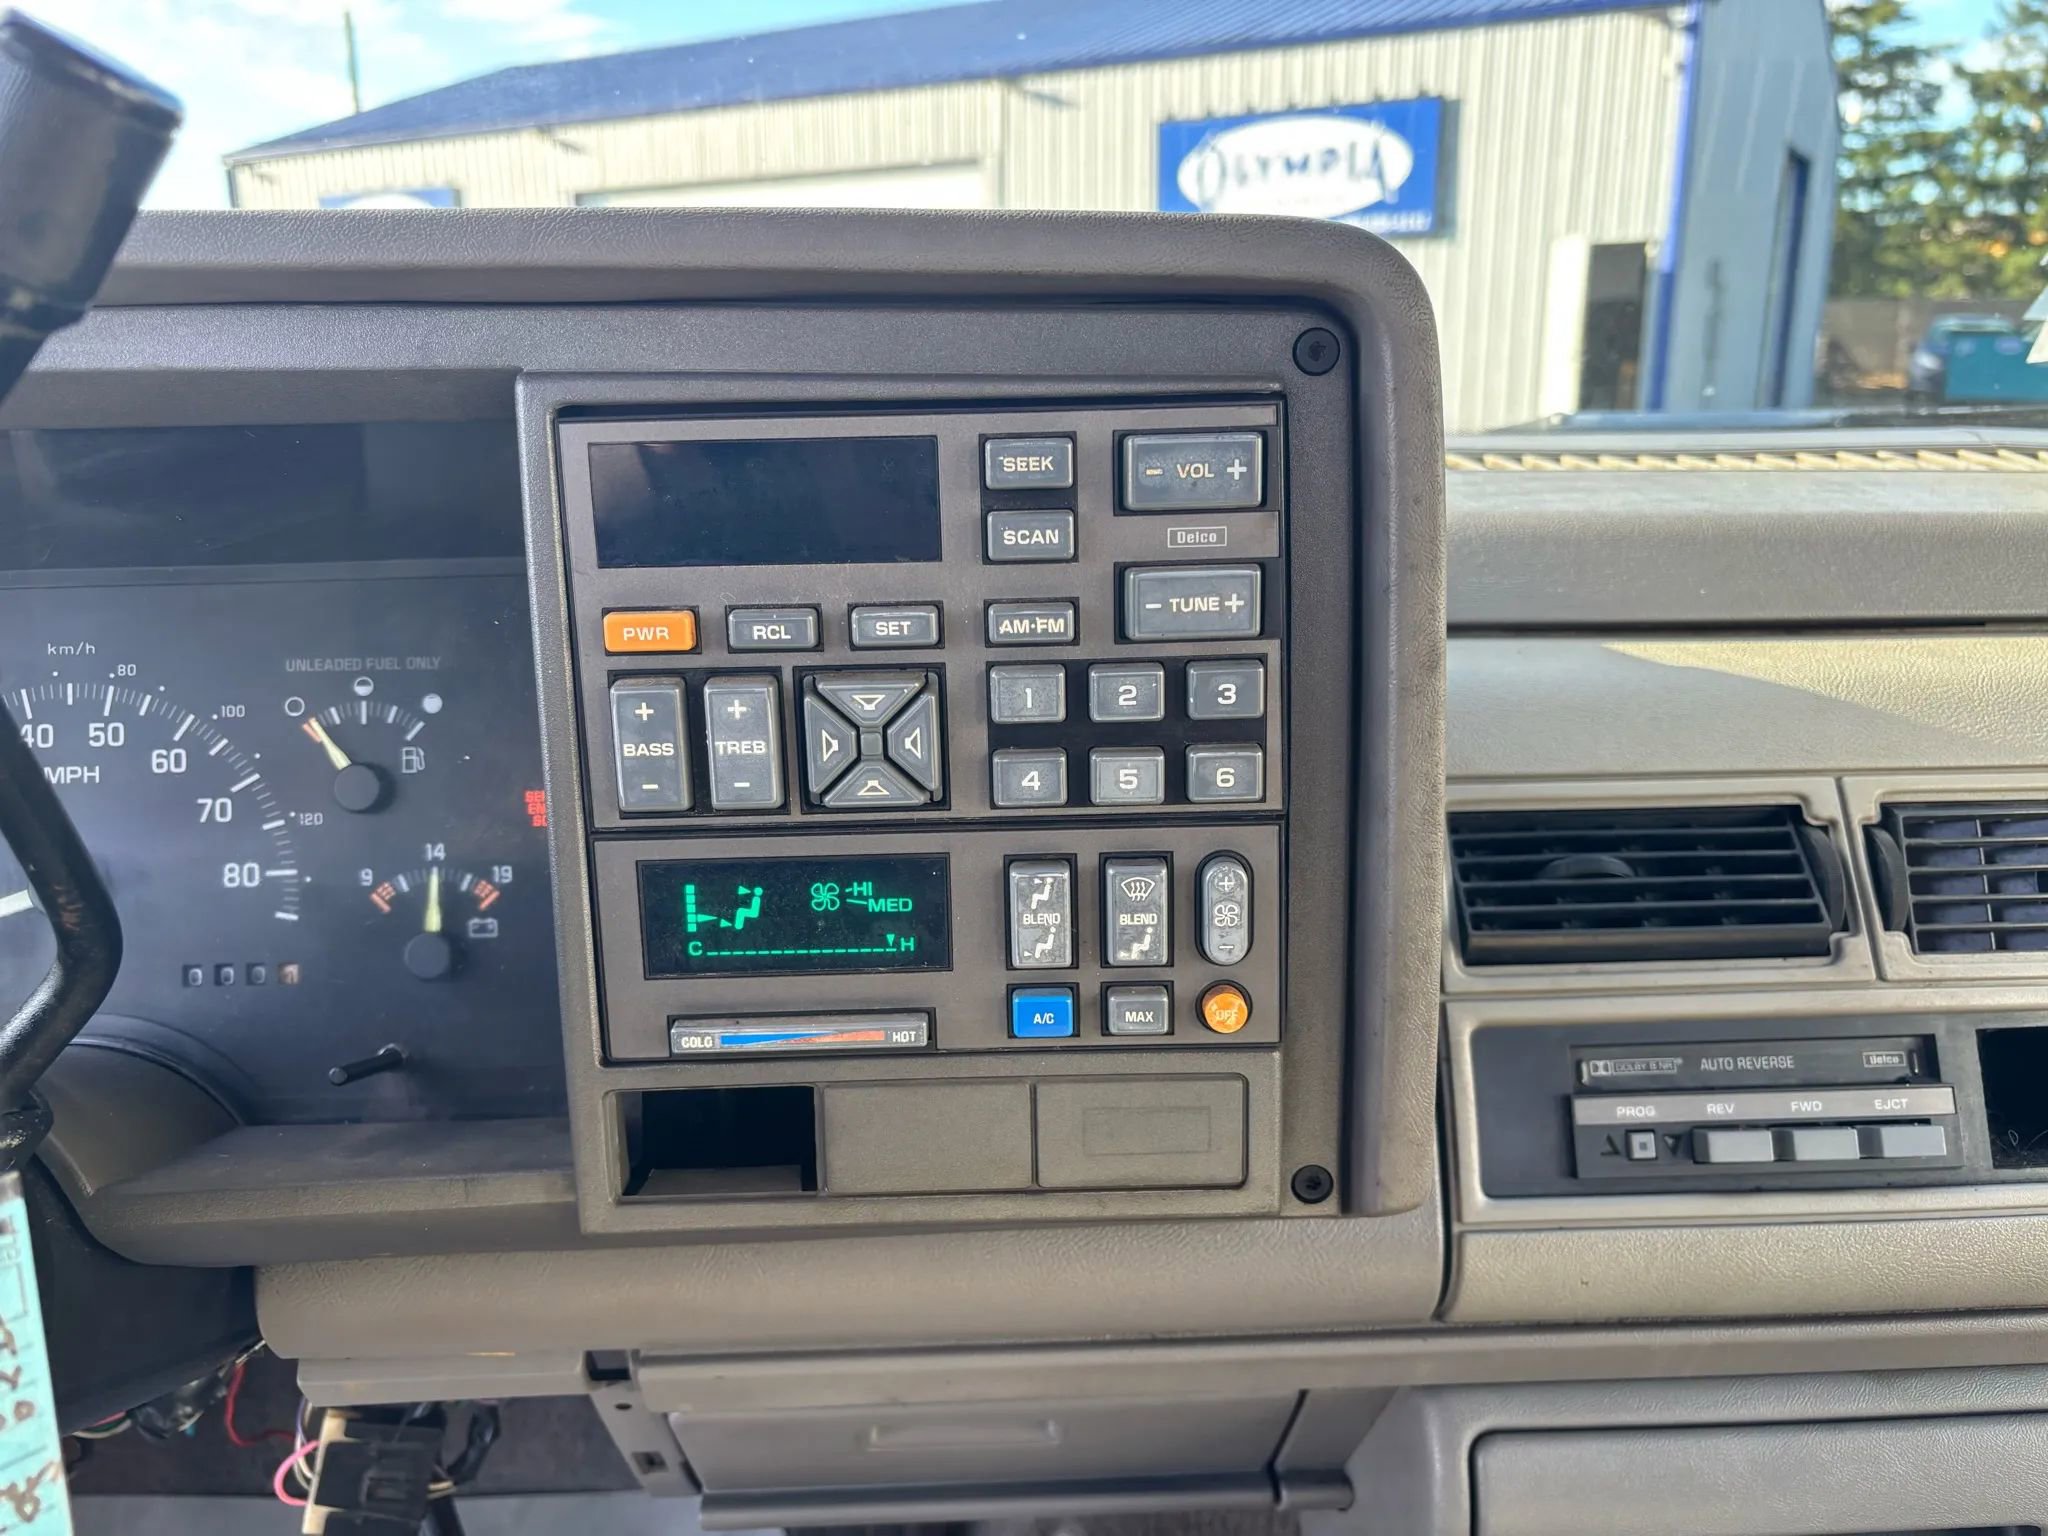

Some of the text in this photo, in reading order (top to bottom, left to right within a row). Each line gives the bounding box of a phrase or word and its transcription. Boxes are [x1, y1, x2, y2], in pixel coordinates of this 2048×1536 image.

[1002, 456, 1054, 473] SEEK
[1176, 463, 1215, 479] VOL
[1003, 528, 1059, 545] SCAN
[1176, 530, 1217, 545] Delco
[1169, 596, 1220, 613] TUNE
[623, 627, 670, 641] PWR
[753, 625, 791, 640] RCL
[876, 621, 912, 636] SET
[47, 641, 96, 656] km/h
[117, 664, 137, 677] 80
[285, 655, 441, 672] UNLEADED FUEL ONLY
[1024, 687, 1033, 709] 1
[1118, 685, 1138, 706] 2
[1217, 683, 1237, 705] 3
[220, 704, 246, 718] 100
[20, 723, 54, 749] 40
[88, 722, 125, 747] 50
[623, 743, 674, 757] BASS
[714, 740, 766, 755] TREB
[151, 748, 188, 774] 60
[43, 765, 100, 785] MPH
[1021, 770, 1041, 791] 4
[1119, 769, 1138, 790] 5
[1216, 767, 1236, 788] 6
[196, 797, 233, 823] 70
[300, 812, 324, 826] 120
[424, 842, 446, 861] 14
[223, 862, 260, 888] 80
[360, 868, 374, 887] 9
[492, 865, 513, 883] 19
[853, 882, 873, 897] HI
[868, 898, 913, 913] MED
[1023, 913, 1061, 926] BLEND
[1119, 913, 1157, 926] BLEND
[688, 942, 703, 956] C
[900, 937, 915, 952] H
[1033, 1012, 1055, 1026] A/C
[1125, 1010, 1154, 1024] MAX
[1215, 1009, 1239, 1025] OFF
[892, 1031, 917, 1043] HOT
[1701, 1055, 1795, 1071] AUTO REVERSE
[1616, 1105, 1656, 1119] PROG
[1707, 1103, 1735, 1115] REV
[1791, 1100, 1823, 1113] FWD
[1874, 1098, 1909, 1111] EJCT
